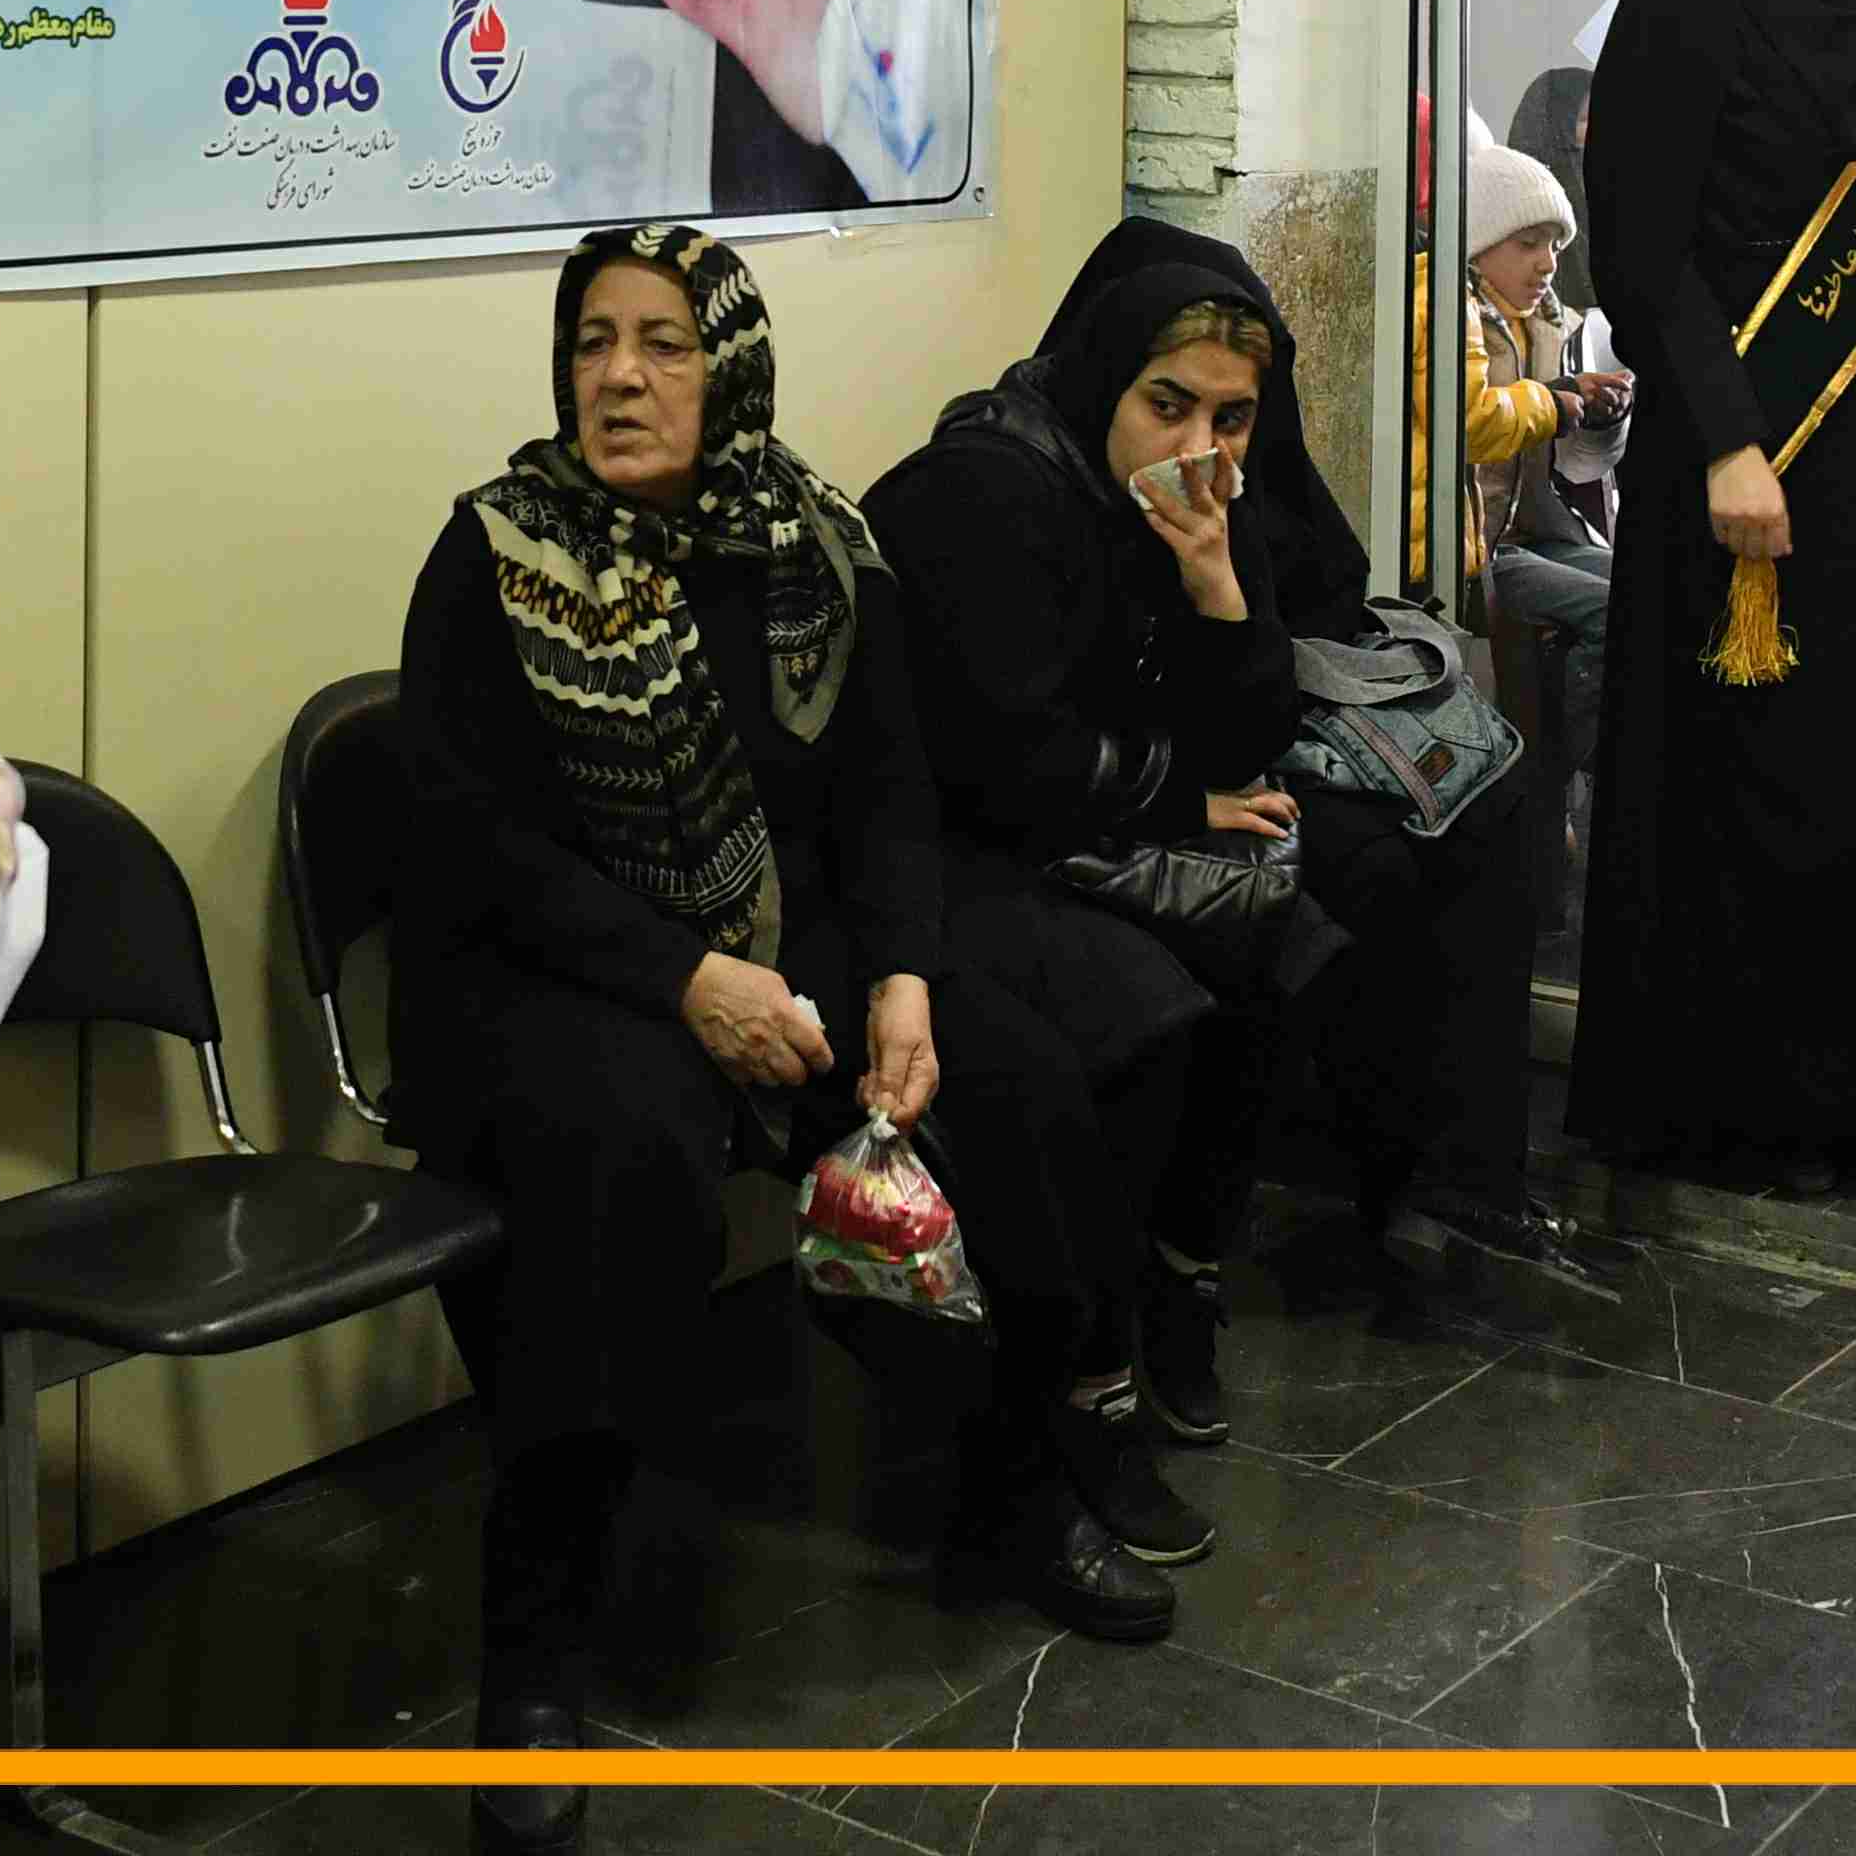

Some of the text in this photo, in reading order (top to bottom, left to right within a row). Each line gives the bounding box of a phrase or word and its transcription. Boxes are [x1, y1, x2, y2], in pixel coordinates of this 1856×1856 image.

[16, 6, 72, 49] معظم
[70, 6, 115, 48] مقام
[204, 125, 239, 158] نفت
[238, 127, 280, 156] صنعت
[275, 136, 305, 162] درمان
[311, 124, 361, 158] بهداشت
[360, 129, 397, 158] سازمان
[297, 167, 334, 209] شورای
[408, 162, 435, 190] نفت
